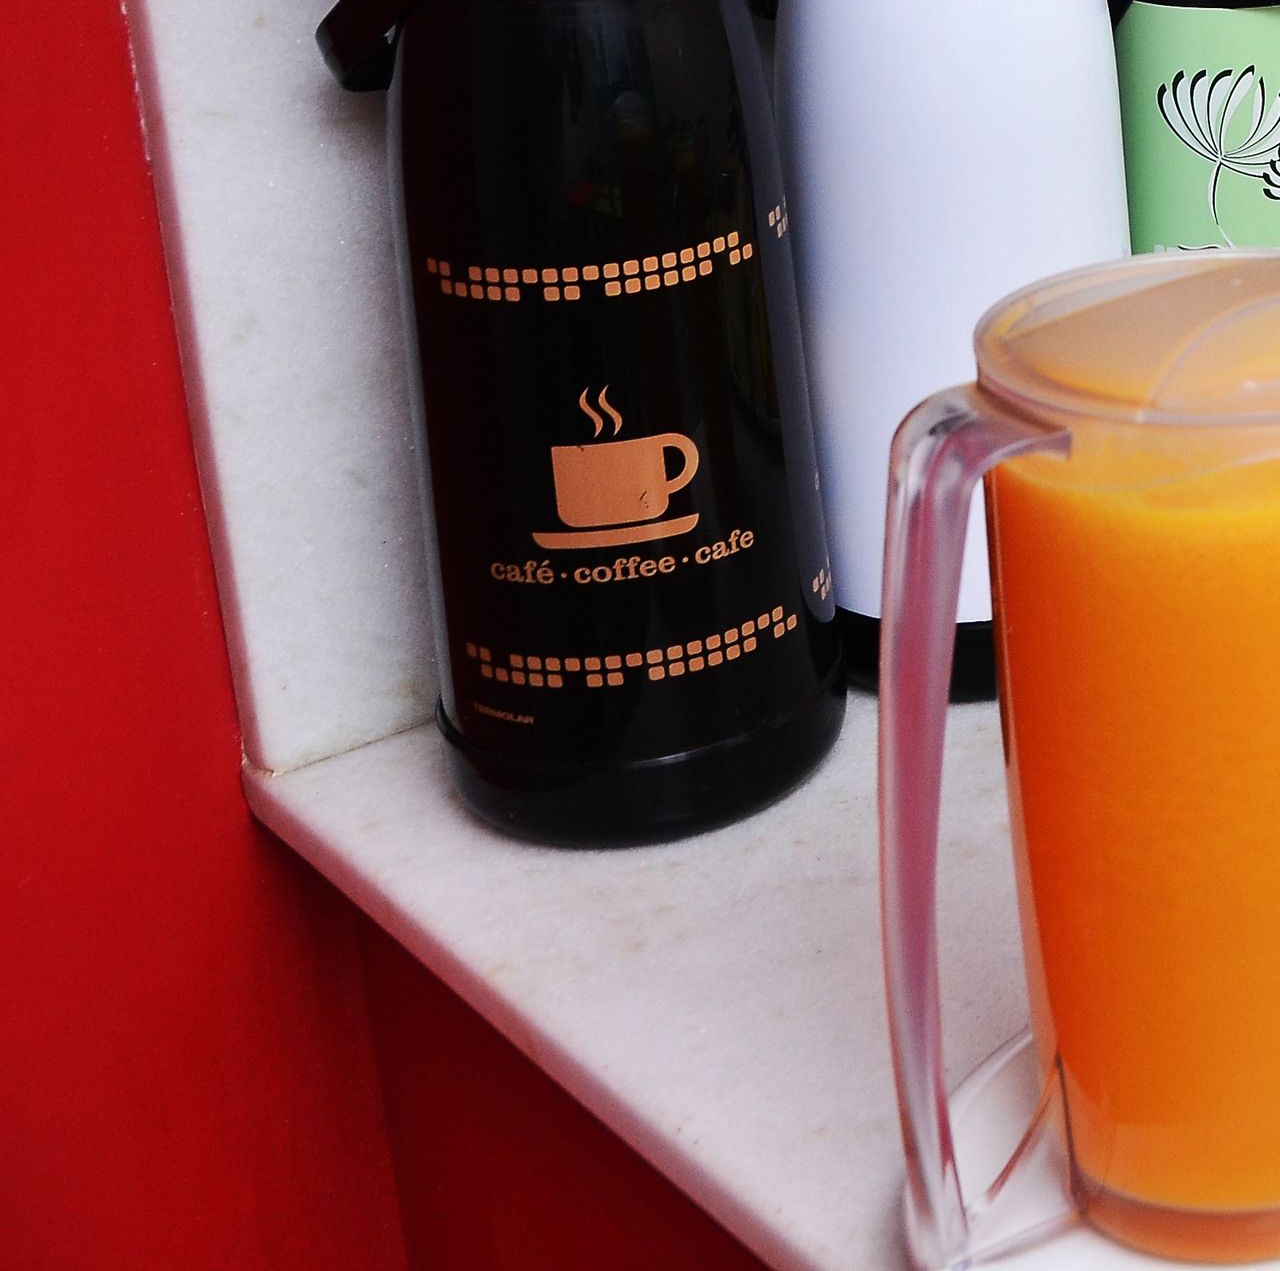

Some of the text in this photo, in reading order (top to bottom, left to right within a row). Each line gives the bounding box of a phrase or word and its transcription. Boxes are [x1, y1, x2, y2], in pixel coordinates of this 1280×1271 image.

[490, 529, 755, 585] café coffee cafe
